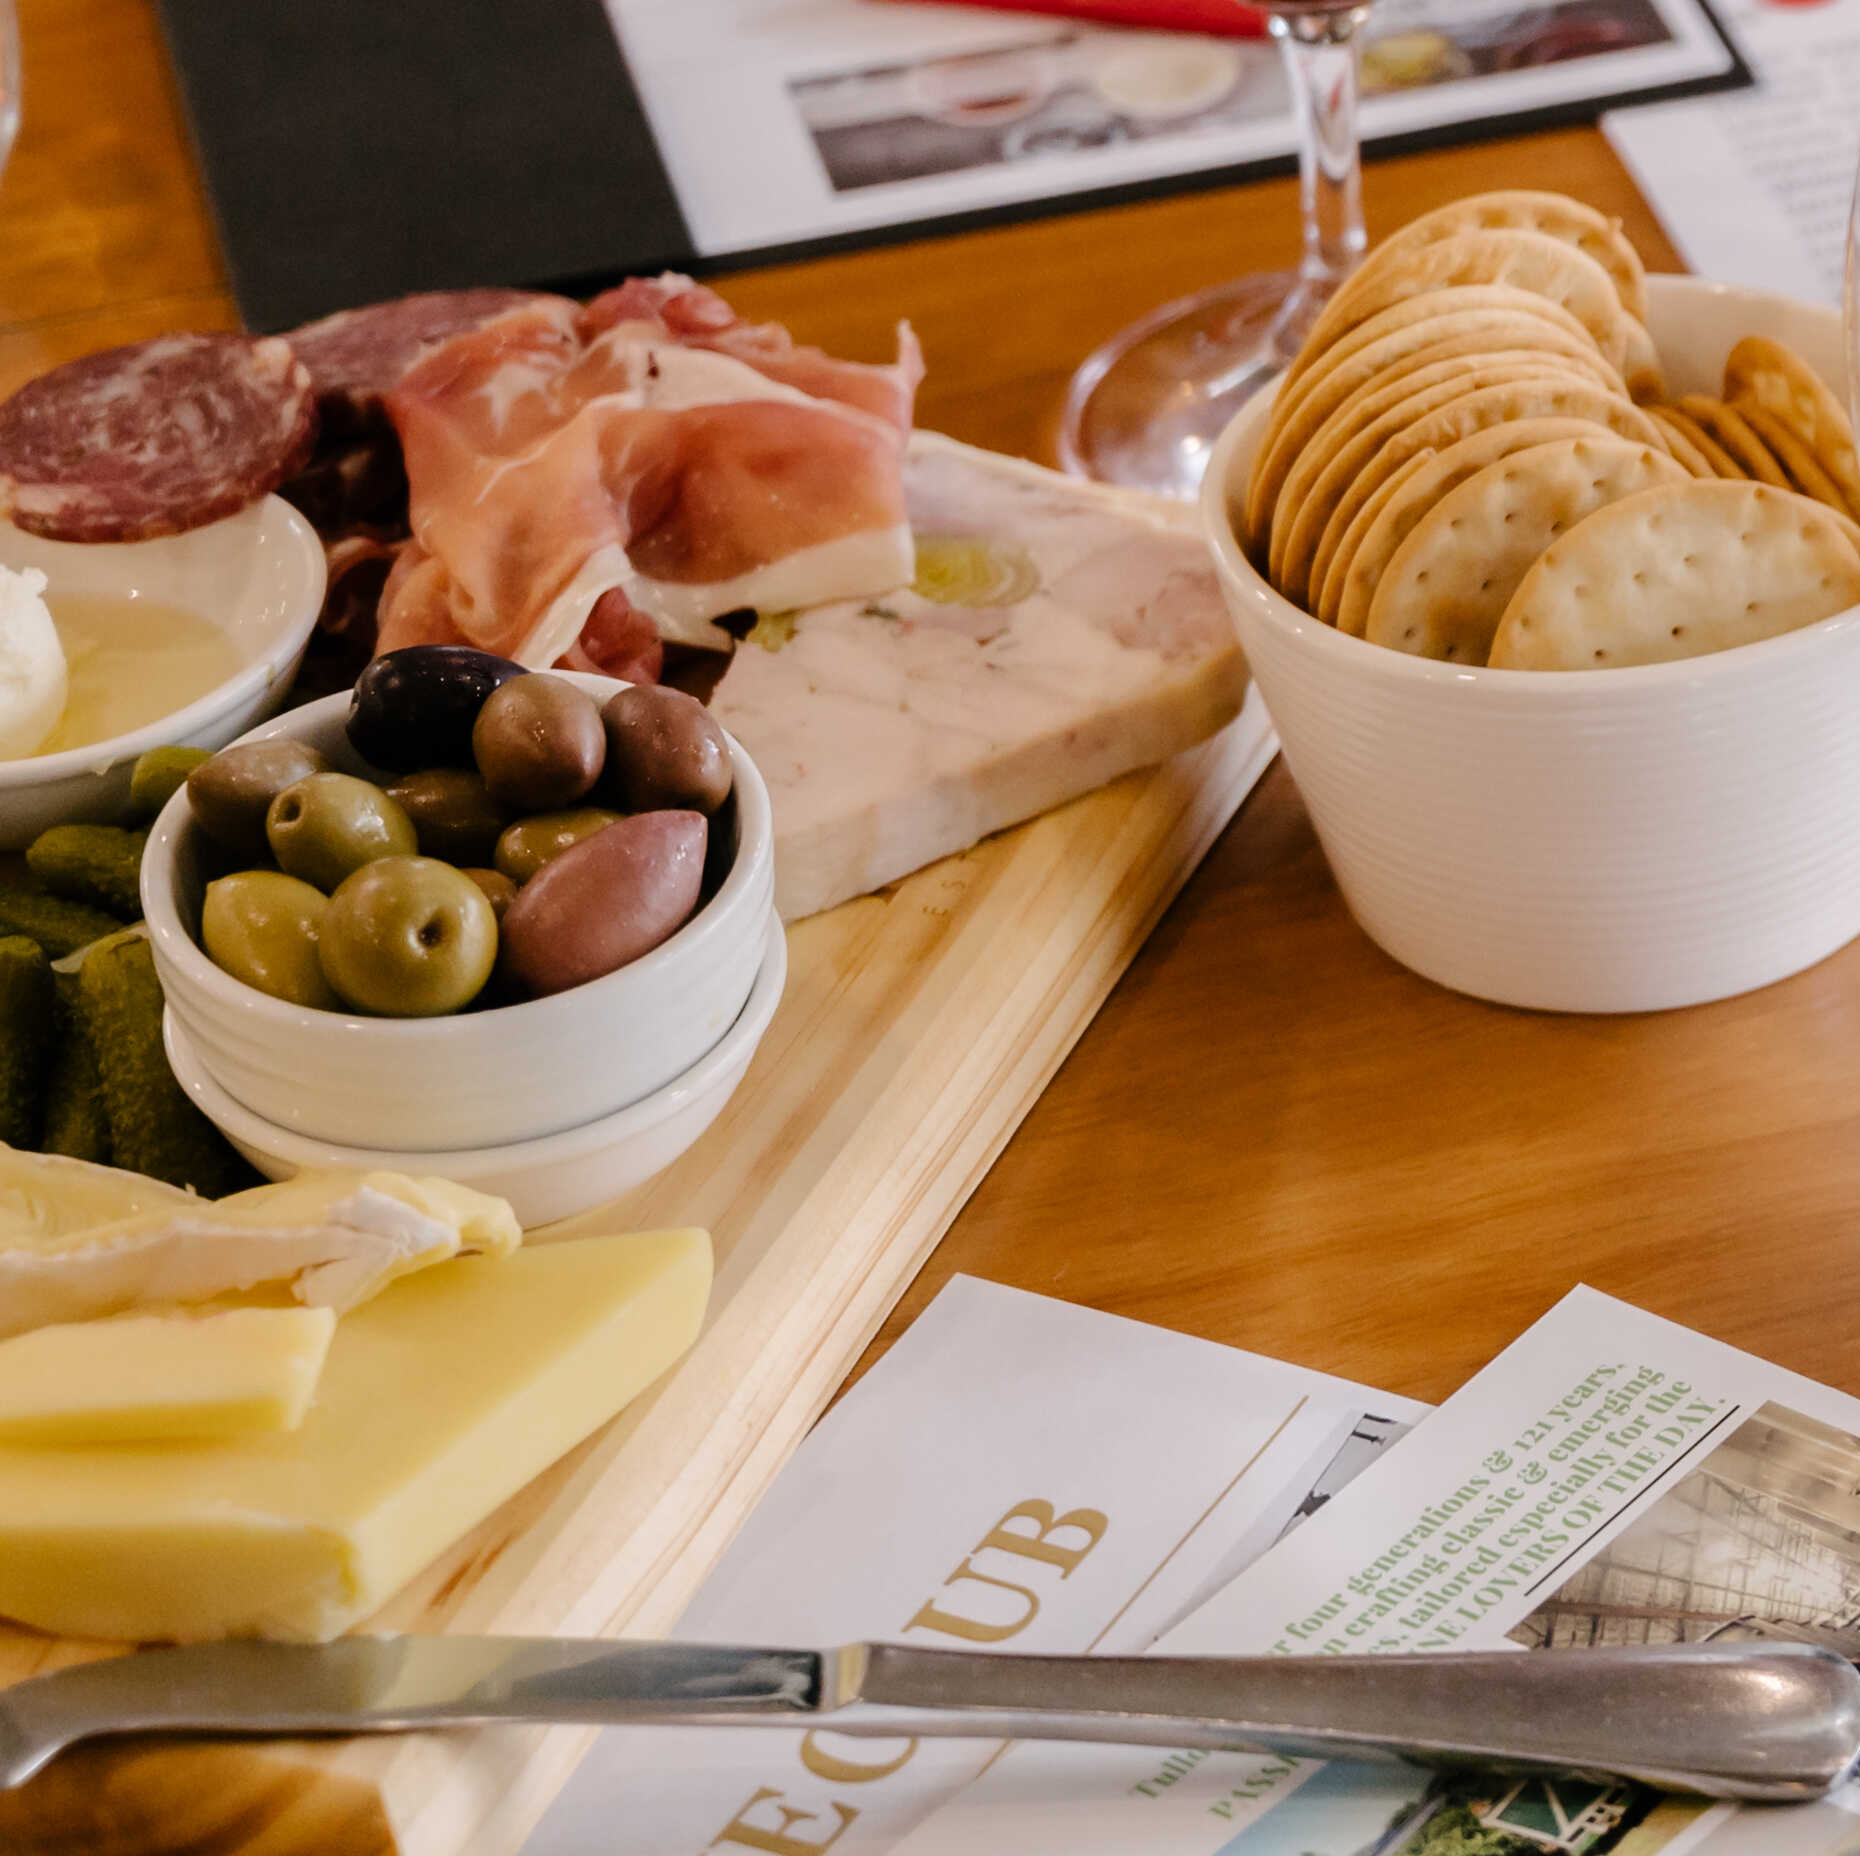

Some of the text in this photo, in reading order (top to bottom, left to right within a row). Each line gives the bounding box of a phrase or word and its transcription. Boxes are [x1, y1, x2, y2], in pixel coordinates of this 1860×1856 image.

[1285, 1592, 1350, 1641] four
[1347, 1474, 1492, 1597] generations
[1481, 1447, 1514, 1475] &
[1512, 1417, 1557, 1454] 121
[1344, 1364, 1666, 1638] crafting classic & emerging
[1398, 1379, 1695, 1642] tailored especially for the
[1467, 1530, 1571, 1627] LOVERS
[1561, 1495, 1605, 1532] OF
[1596, 1446, 1666, 1497] THE
[1654, 1395, 1728, 1451] DAY.
